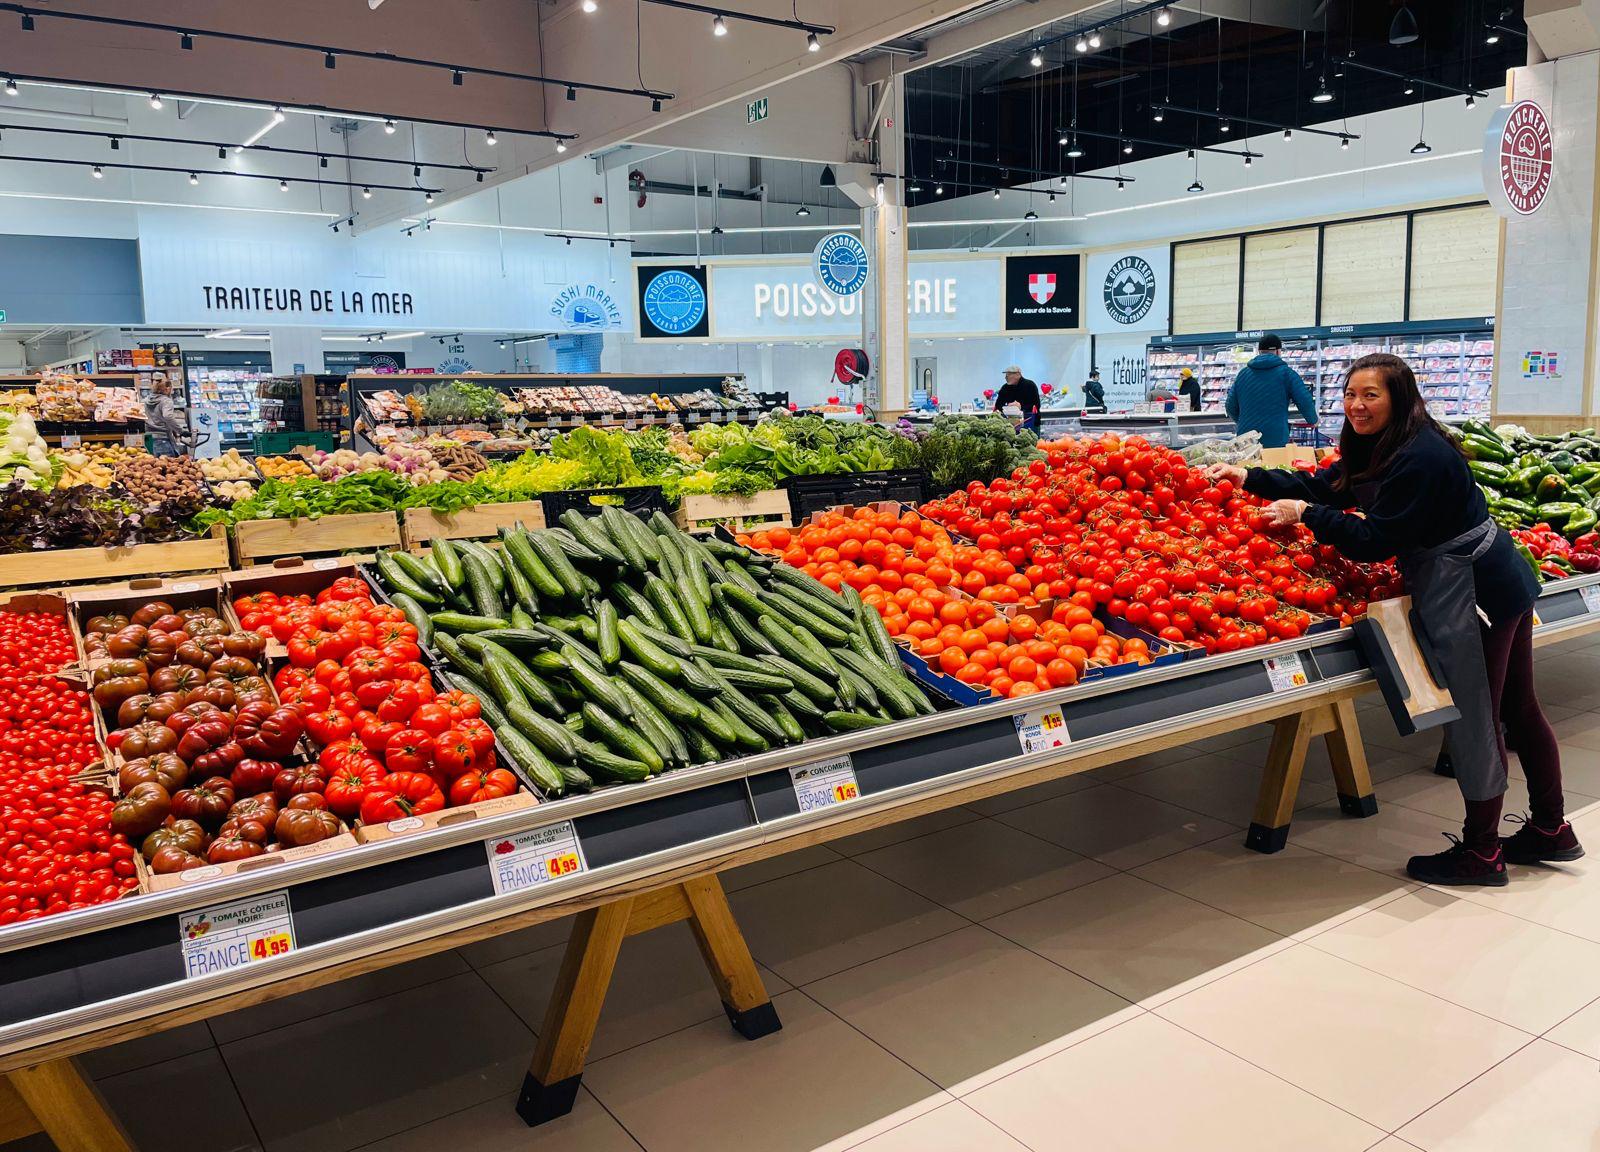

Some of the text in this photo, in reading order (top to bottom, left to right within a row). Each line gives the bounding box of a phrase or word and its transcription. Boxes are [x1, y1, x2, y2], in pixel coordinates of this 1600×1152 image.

[1504, 108, 1550, 152] BOUCHERIE
[822, 236, 866, 263] POISSONNERIE
[648, 275, 701, 300] POISSONNERIE
[1104, 258, 1154, 292] LE GRAND VERGER
[203, 286, 413, 314] TRAITEUR DE LA MER
[551, 285, 621, 325] SUSHI MARKET
[810, 761, 850, 776] CONCOMBRE
[800, 788, 834, 811] ESPAGNE
[515, 834, 541, 845] TOMATE
[533, 836, 556, 846] ROUGE
[499, 862, 547, 890] FRANCE
[212, 910, 247, 923] TOMATE
[237, 913, 263, 924] NOIRE
[188, 943, 248, 977] FRANCE
